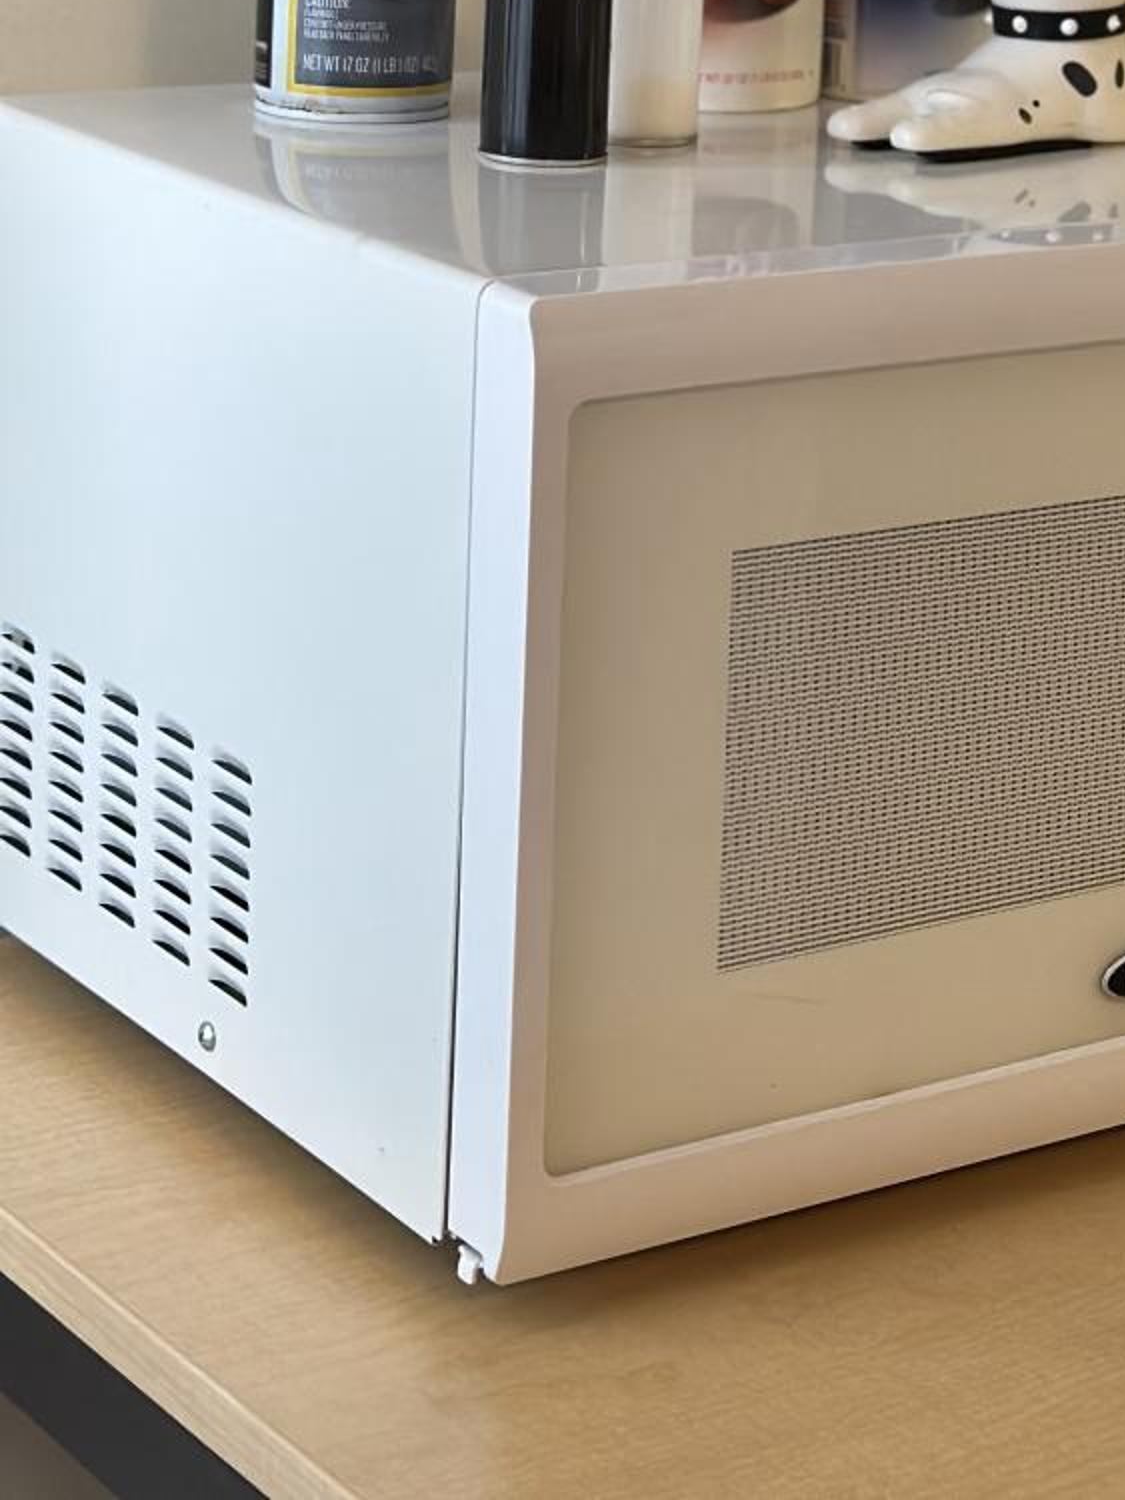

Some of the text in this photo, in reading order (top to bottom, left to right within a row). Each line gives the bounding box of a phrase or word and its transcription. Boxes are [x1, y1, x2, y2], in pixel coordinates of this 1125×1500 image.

[303, 53, 320, 71] NET
[324, 55, 340, 72] WT
[355, 56, 369, 73] OZ
